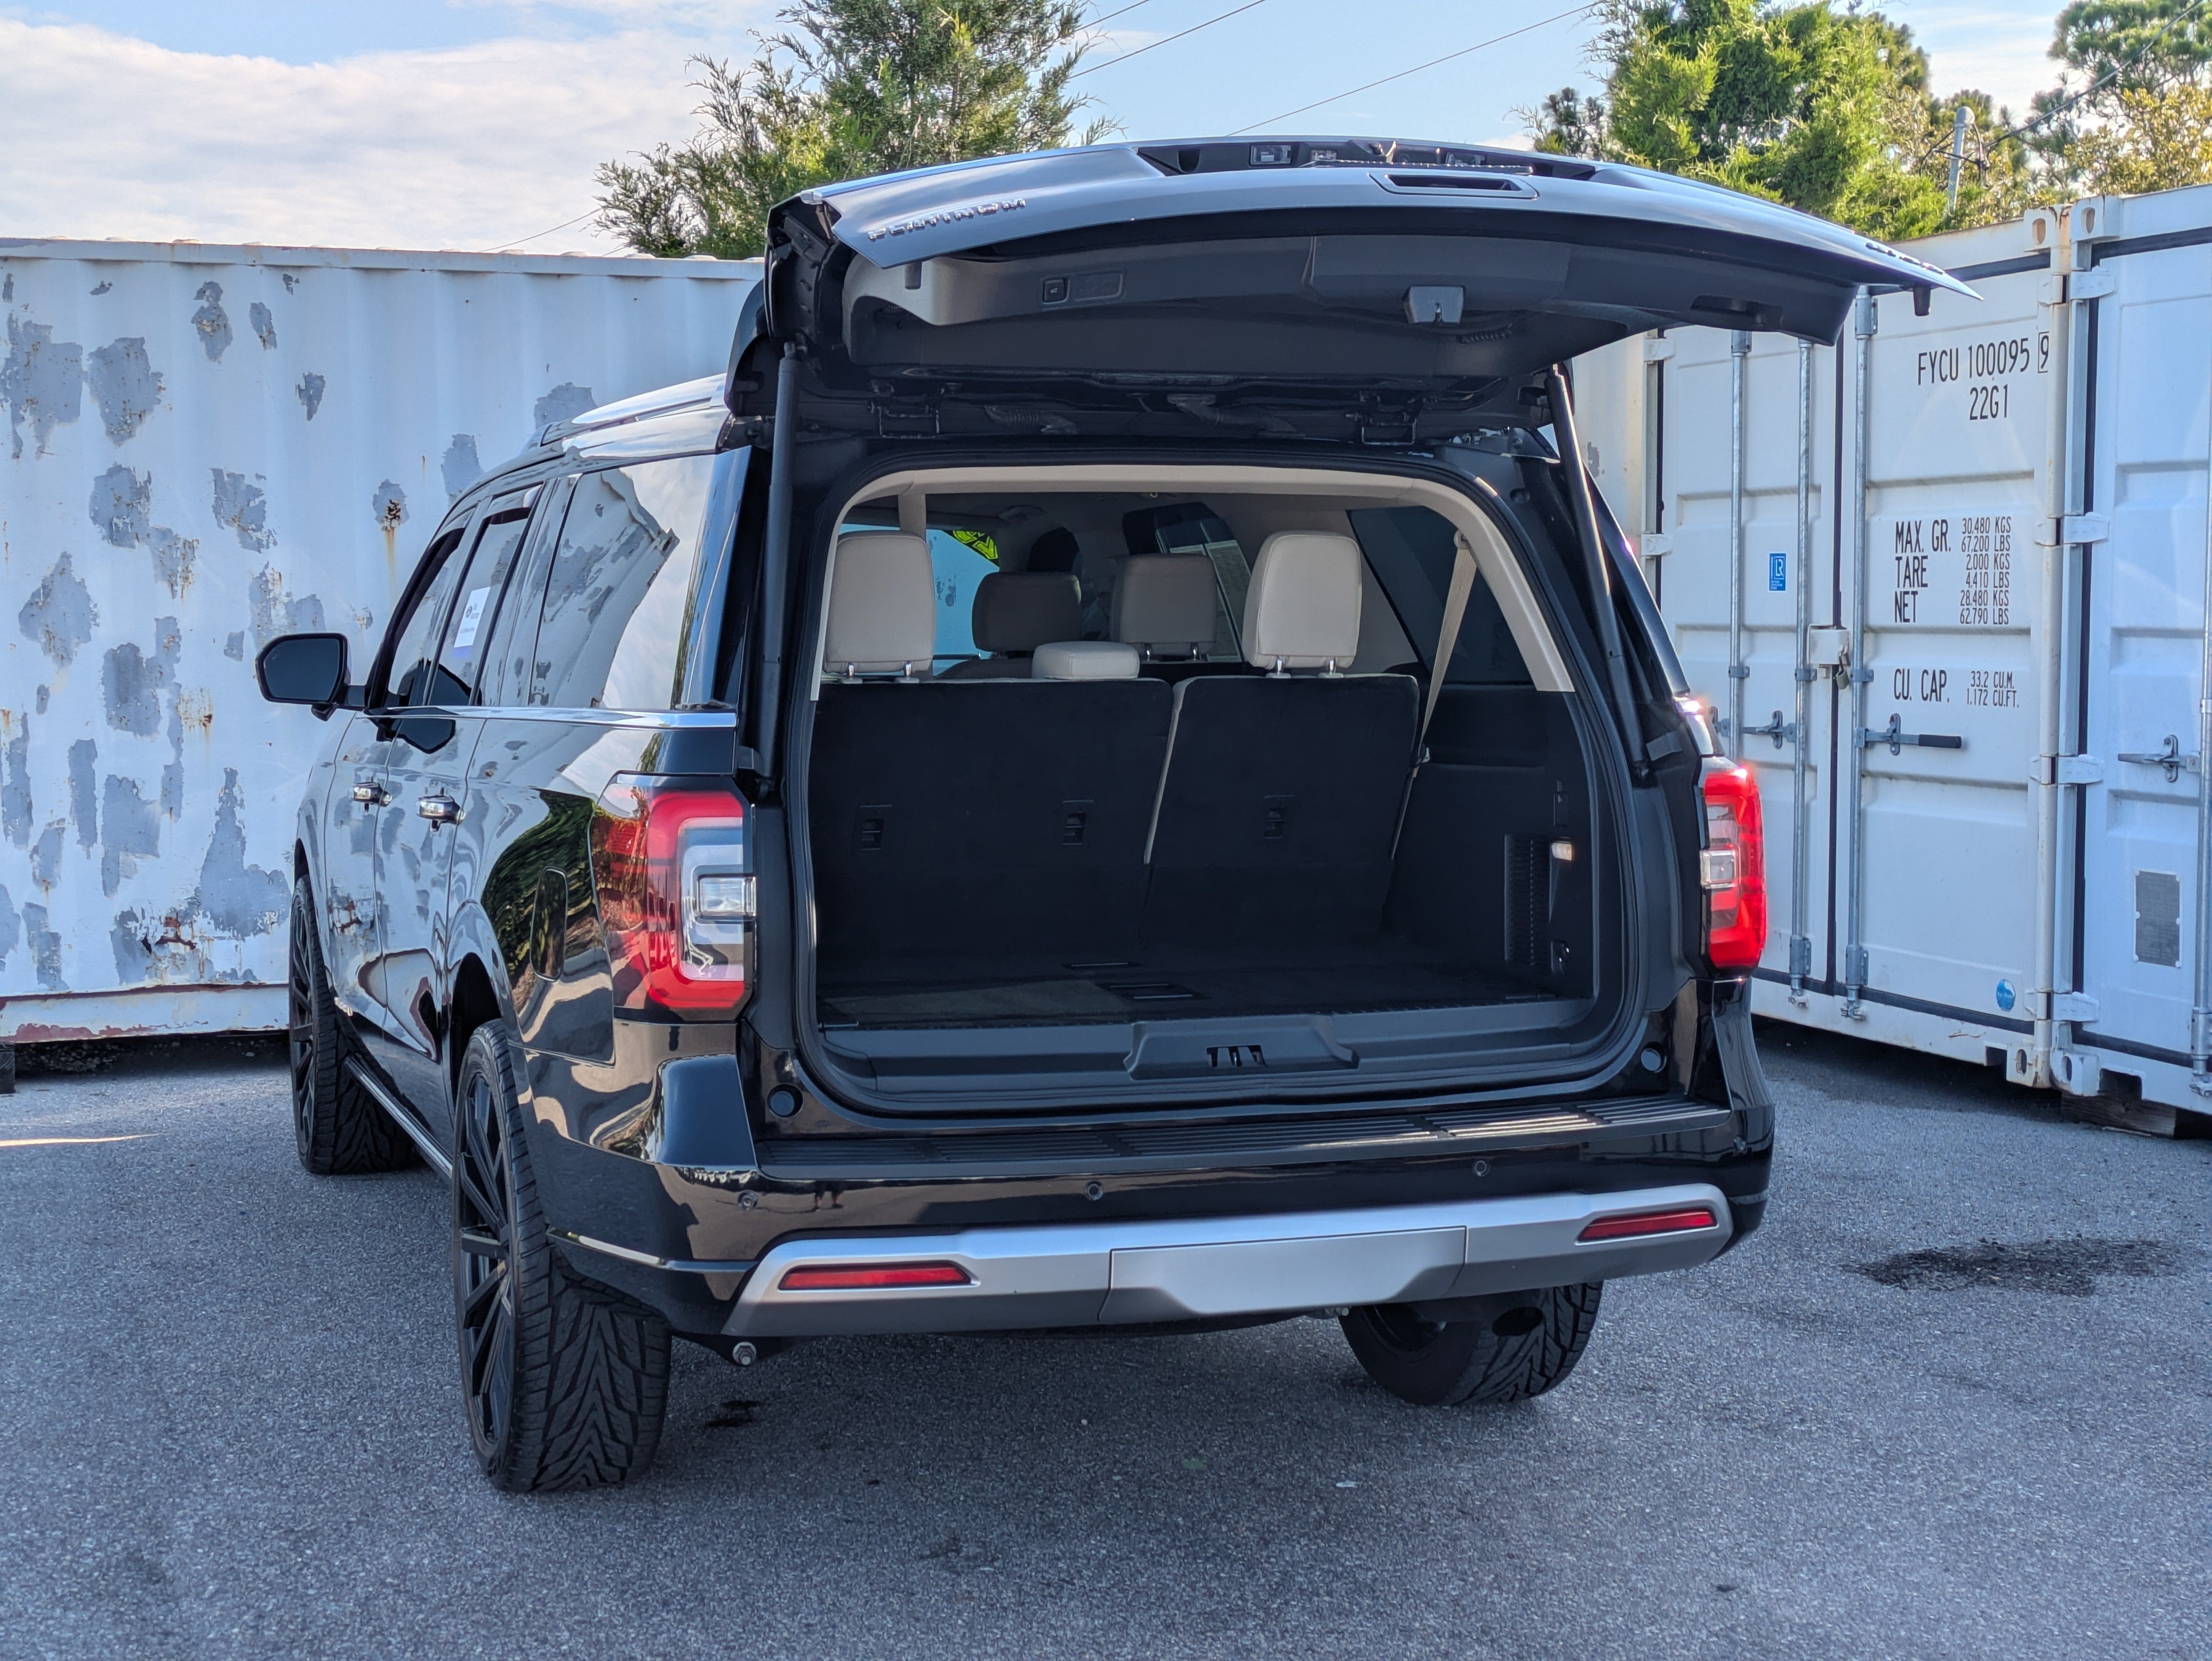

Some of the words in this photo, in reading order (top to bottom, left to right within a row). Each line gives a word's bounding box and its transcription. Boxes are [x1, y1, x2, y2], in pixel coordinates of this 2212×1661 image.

[1918, 348, 1958, 385] FYCU
[1969, 338, 2029, 378] 100095
[2040, 335, 2049, 369] 9
[1969, 384, 2008, 420] 22G1
[1995, 517, 2011, 533] KGS
[1895, 520, 1924, 554] MAX.
[1932, 520, 1951, 552] GR.
[1994, 535, 2010, 552] LBS
[1994, 553, 2010, 570] KGS
[1895, 555, 1928, 588] TARE
[1993, 572, 2009, 588] LBS
[1895, 590, 1918, 623] NET
[1993, 590, 2009, 606] KGS
[1993, 608, 2009, 625] LBS
[1894, 668, 1912, 700] CU.
[1921, 669, 1949, 702] CAP.
[1970, 671, 1989, 687] 33.2
[1993, 672, 2014, 688] CU.M.
[1993, 689, 2019, 708] CU.FT.
